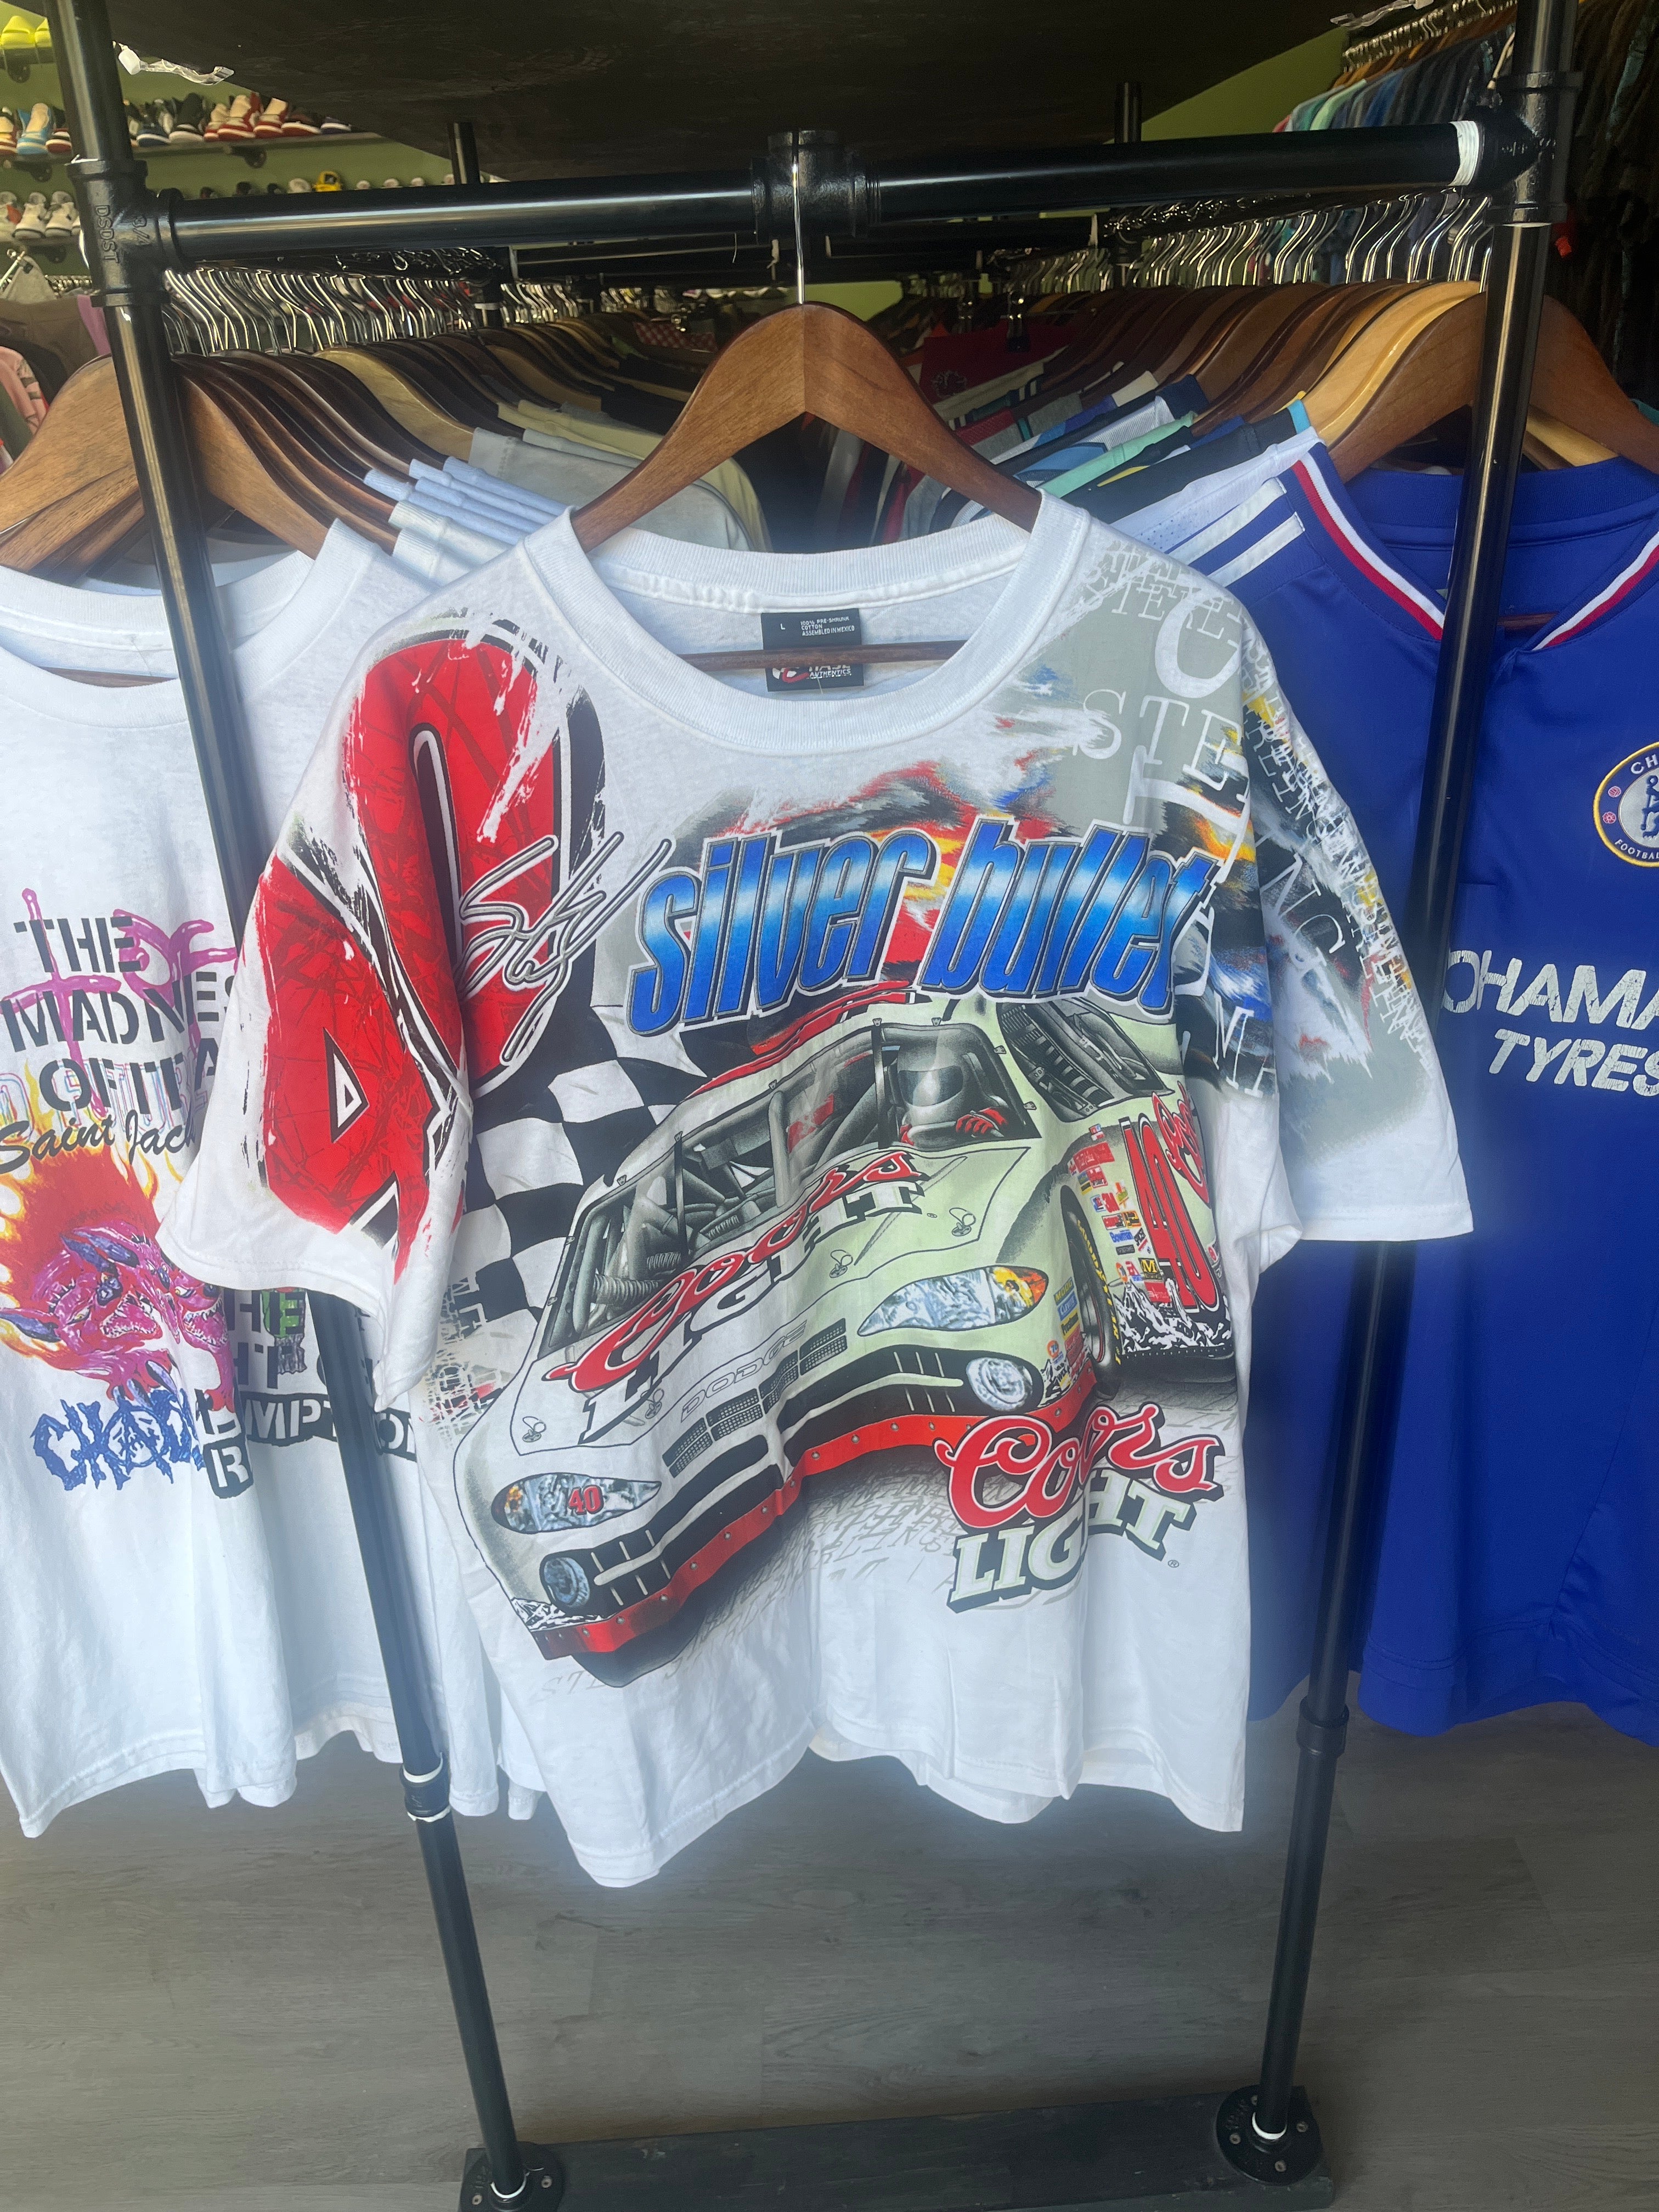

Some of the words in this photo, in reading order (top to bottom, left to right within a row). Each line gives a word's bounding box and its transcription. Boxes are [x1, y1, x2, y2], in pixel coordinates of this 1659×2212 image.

[95, 204, 120, 264] DSDST
[780, 623, 786, 631] L
[802, 627, 831, 637] ASSEMBLED
[837, 624, 855, 633] MEXICO
[816, 616, 850, 624] PRE-SHRUNK
[809, 668, 851, 678] AUTHENTICS
[13, 916, 142, 973] THE
[625, 827, 941, 1037] silver
[918, 815, 1219, 1019] bullet
[0, 1114, 115, 1174] Saint
[542, 1151, 933, 1392] Coors
[680, 1319, 808, 1423] DODGE
[934, 1402, 1226, 1533] Coors
[568, 1485, 604, 1515] 40
[946, 1468, 1197, 1613] LIGHT
